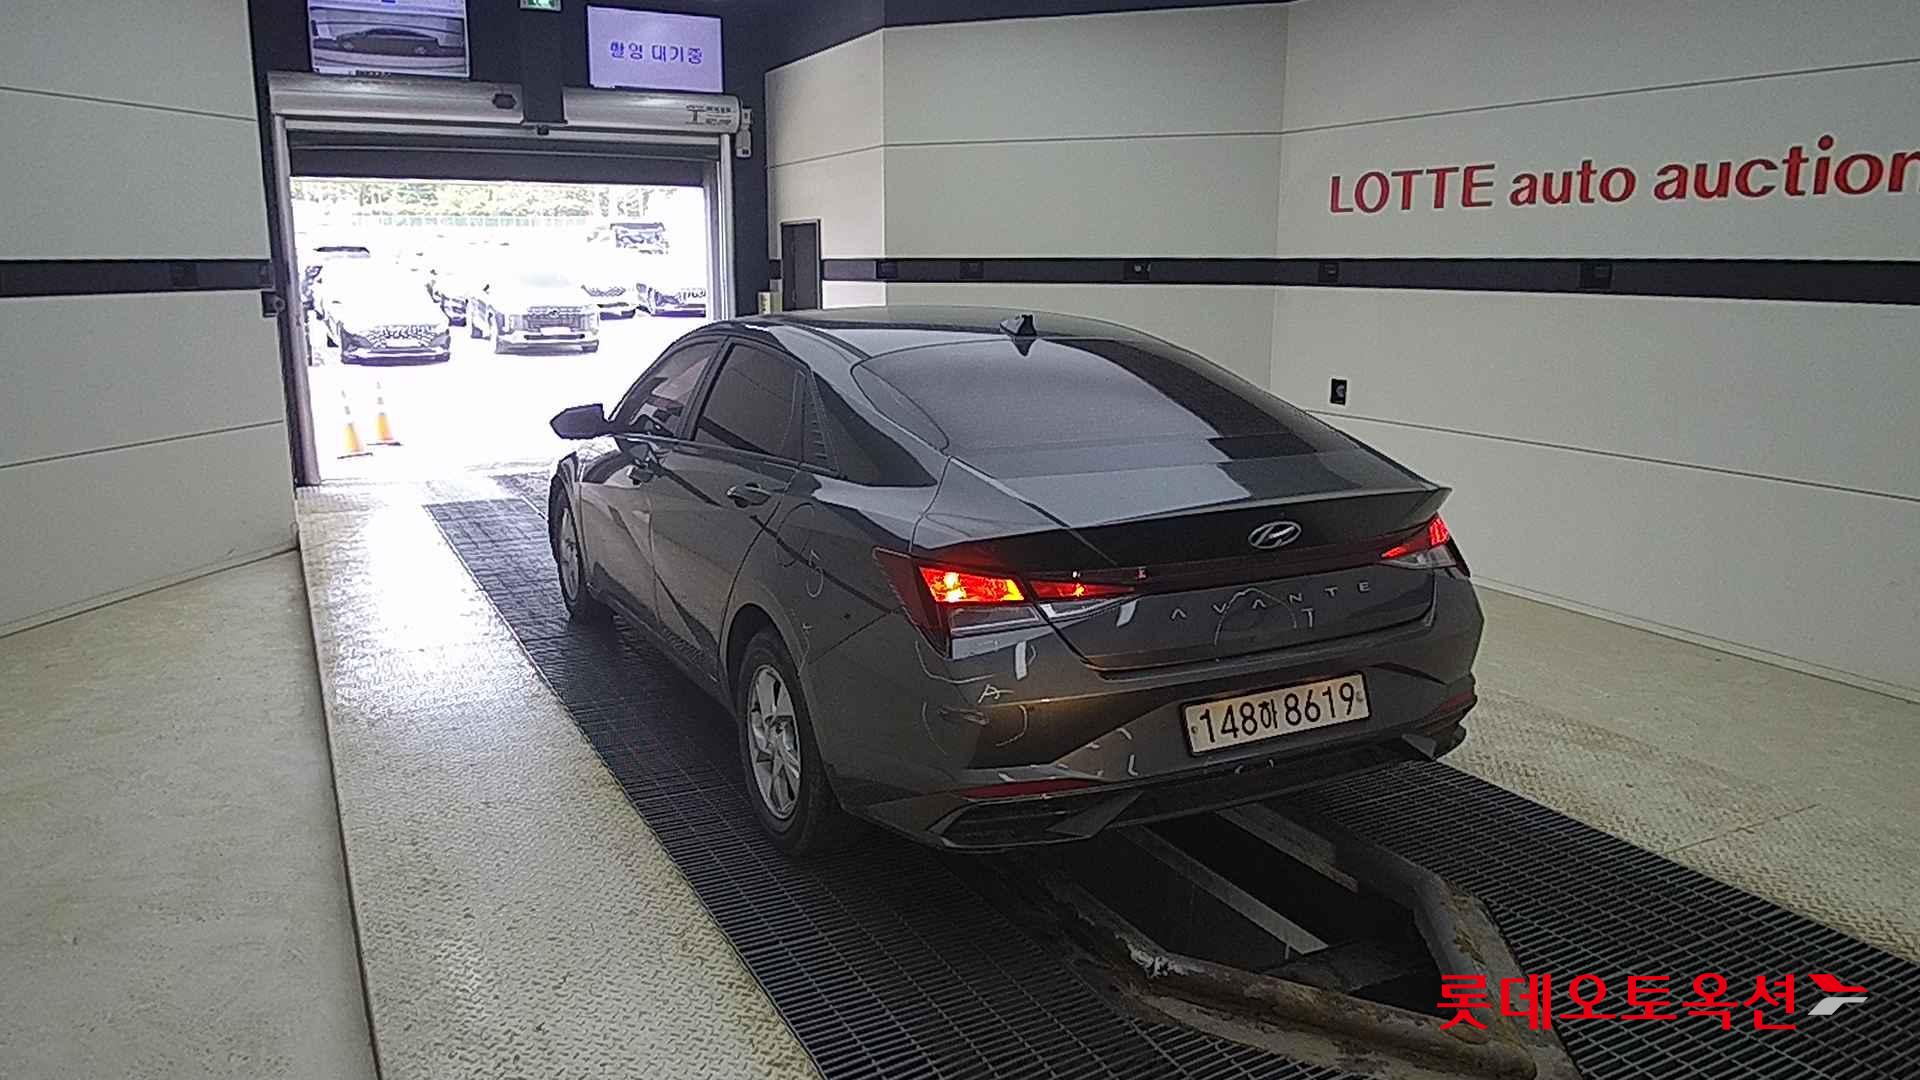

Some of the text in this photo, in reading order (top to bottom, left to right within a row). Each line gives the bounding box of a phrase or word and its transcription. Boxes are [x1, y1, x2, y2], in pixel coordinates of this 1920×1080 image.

[1330, 163, 1496, 213] LOTTE
[1510, 159, 1637, 206] auto
[1169, 581, 1371, 621] AVANTE
